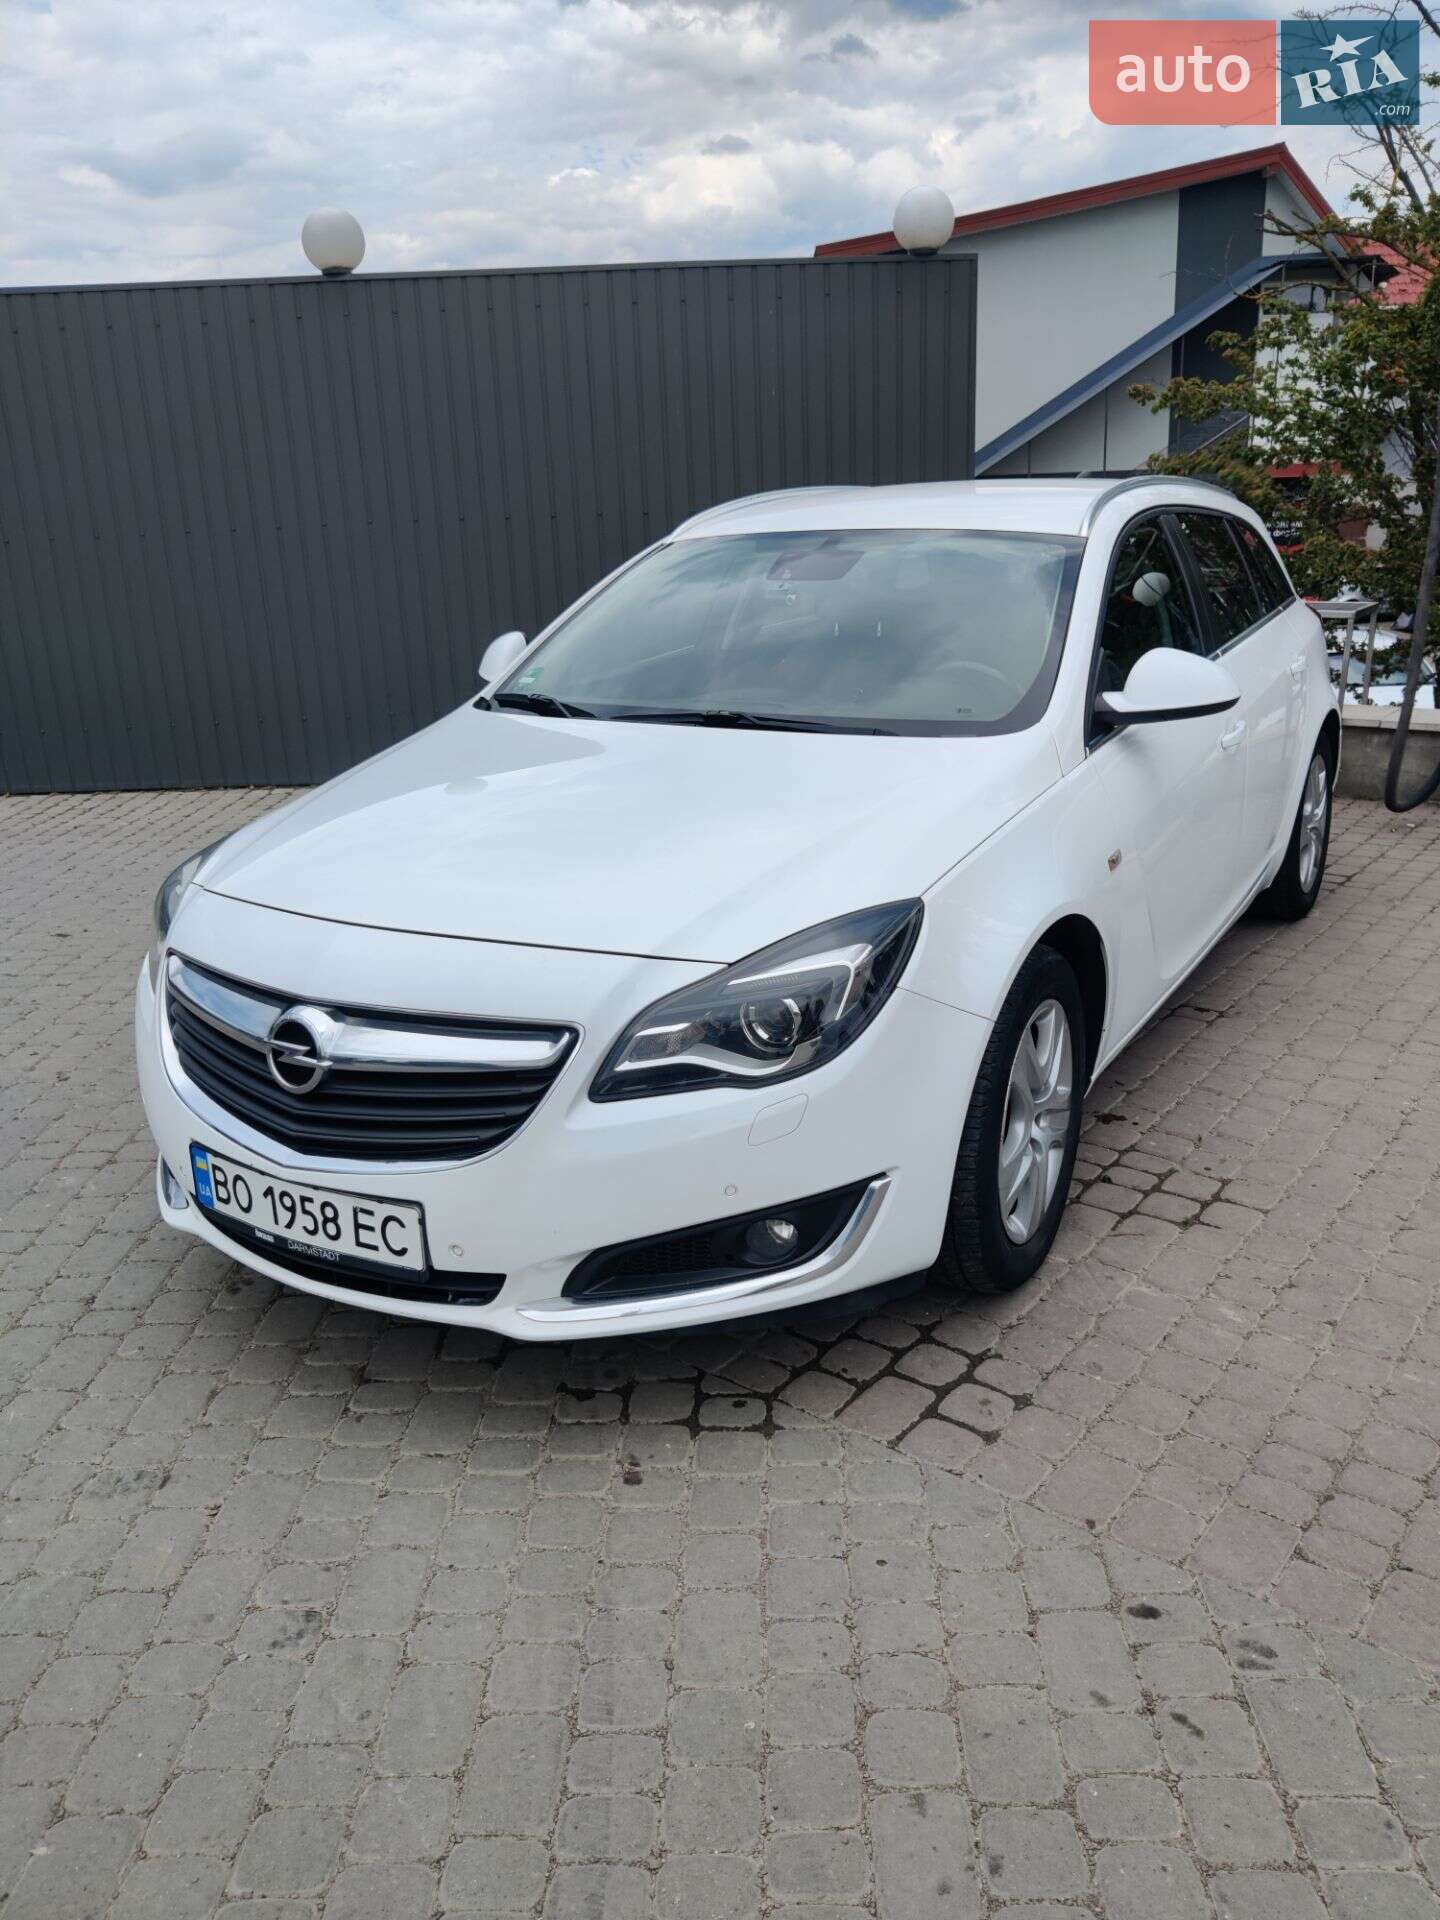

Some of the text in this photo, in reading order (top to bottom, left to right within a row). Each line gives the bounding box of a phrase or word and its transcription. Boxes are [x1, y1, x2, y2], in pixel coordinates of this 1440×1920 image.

[198, 1182, 212, 1197] UA
[211, 1163, 408, 1257] BO 1958 EC
[287, 1239, 340, 1261] DARMSTADT
